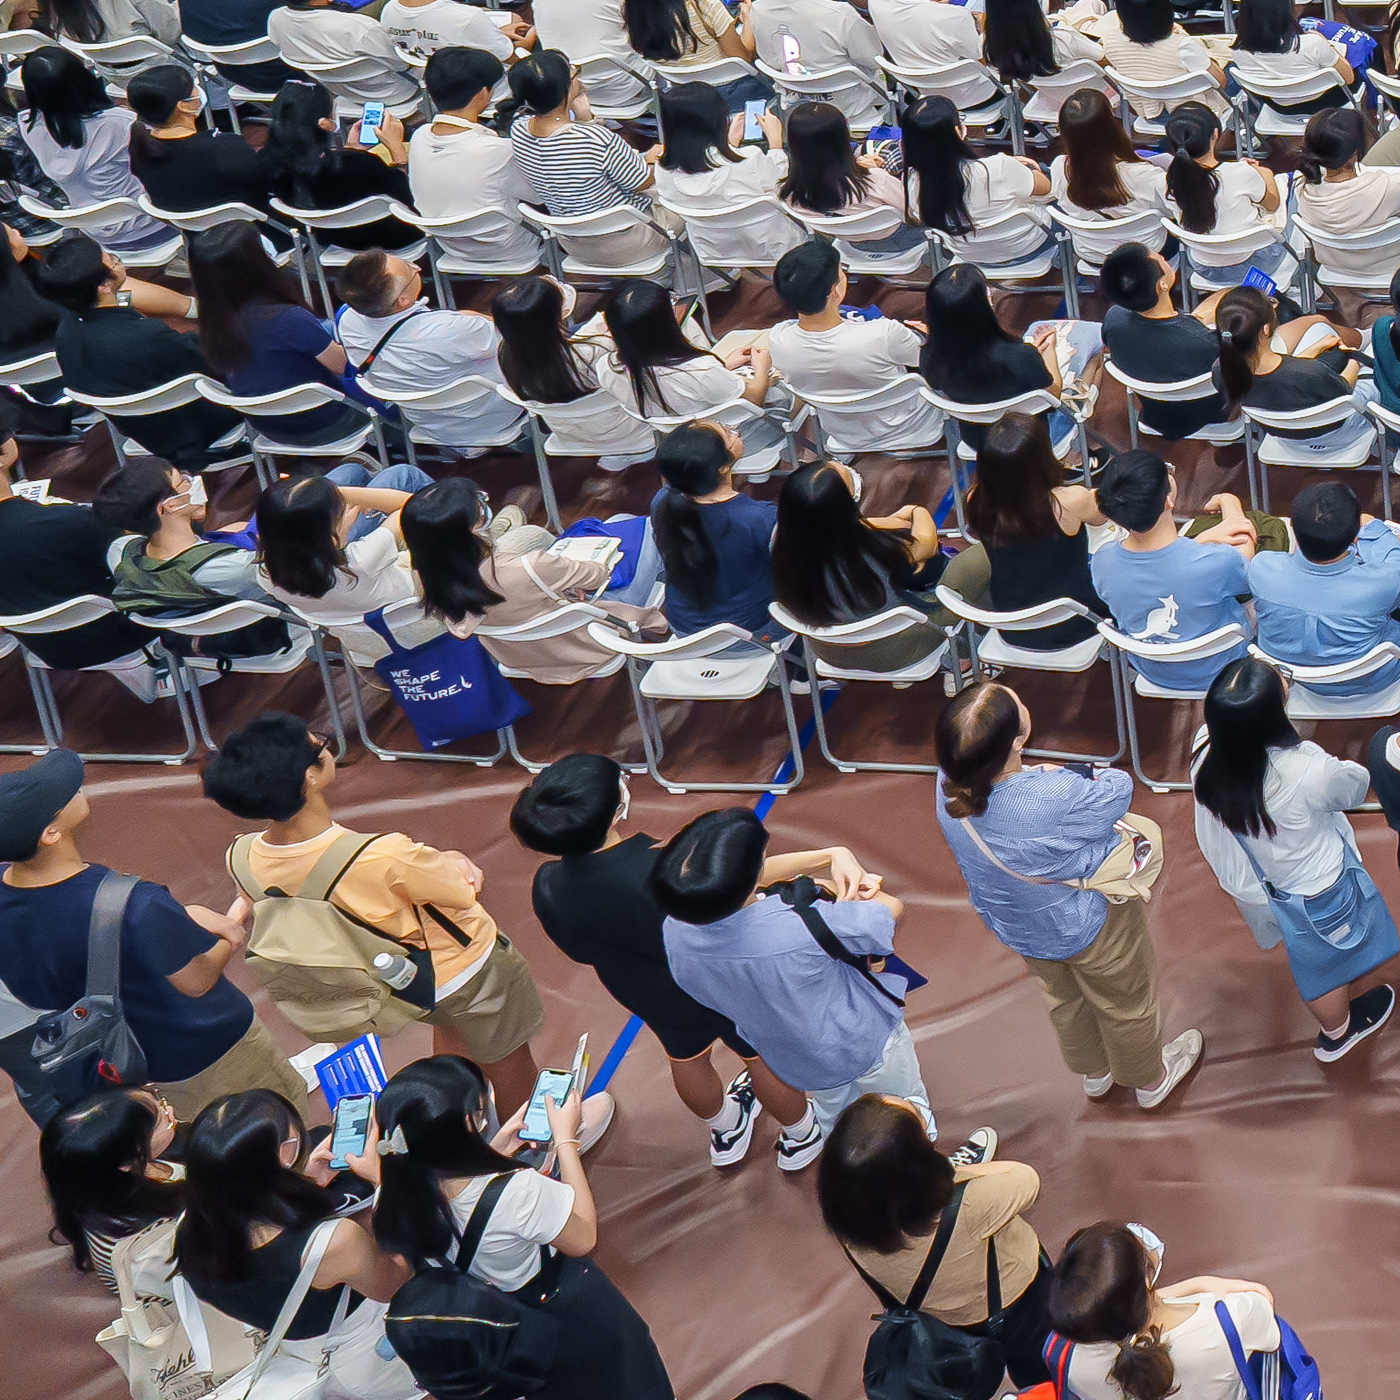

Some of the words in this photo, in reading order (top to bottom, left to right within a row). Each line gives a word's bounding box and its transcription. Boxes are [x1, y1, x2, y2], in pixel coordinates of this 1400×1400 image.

[389, 669, 411, 678] WE
[393, 670, 441, 685] SHAPE
[398, 685, 426, 693] THE
[403, 684, 462, 702] FUTURE.
